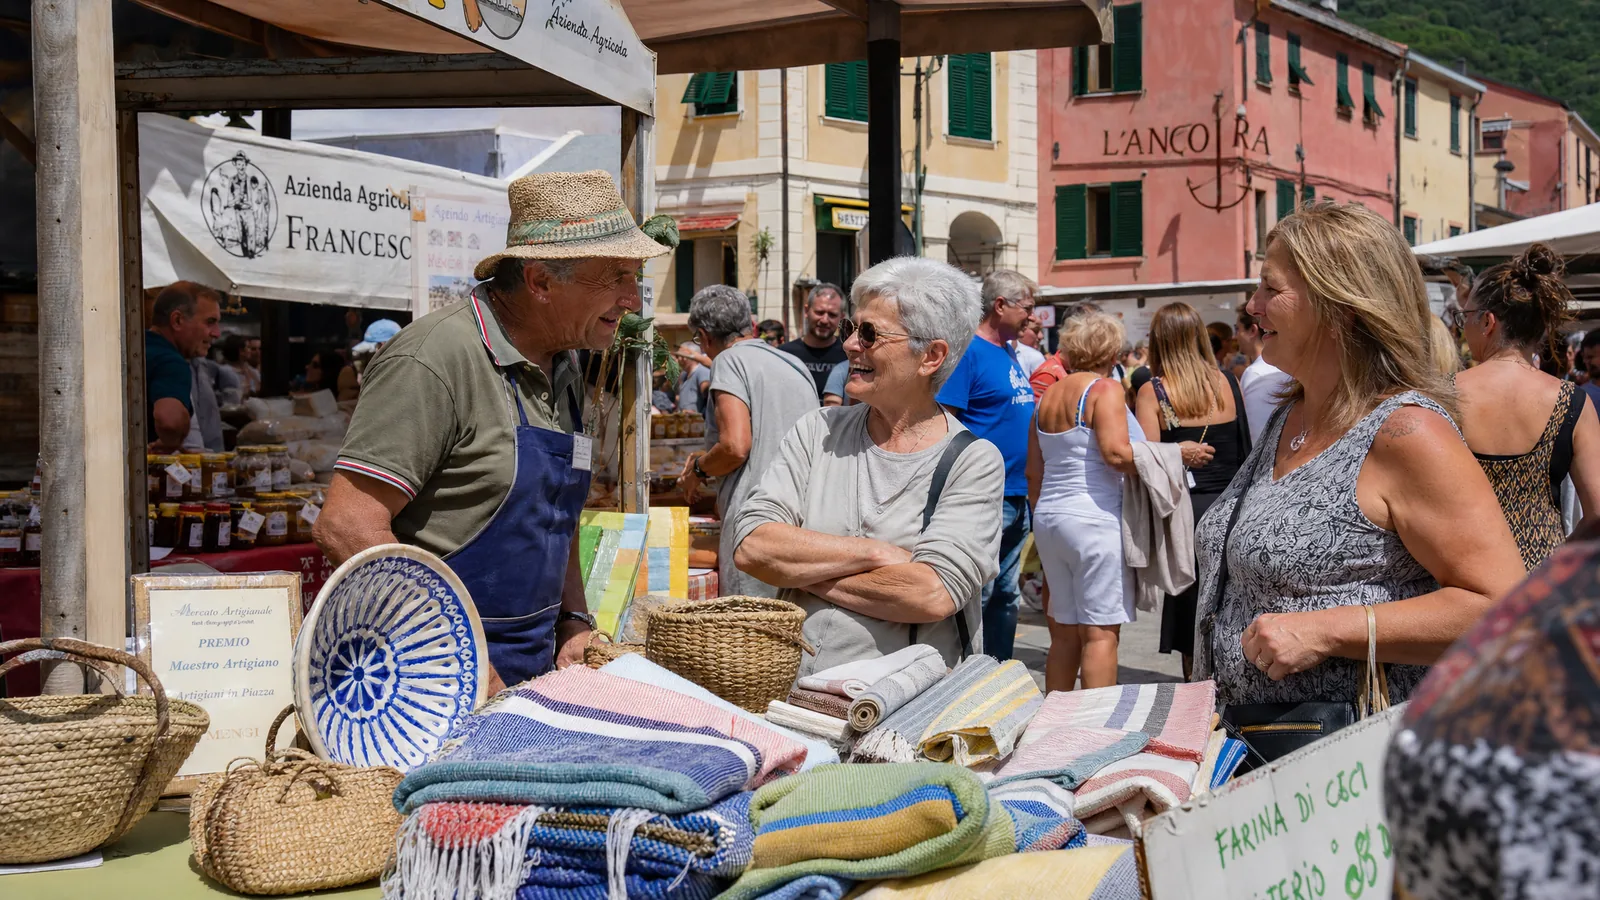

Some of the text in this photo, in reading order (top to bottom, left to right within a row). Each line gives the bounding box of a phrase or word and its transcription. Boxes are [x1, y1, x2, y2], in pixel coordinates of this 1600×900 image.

[590, 25, 628, 58] Agricola
[284, 174, 353, 203] Azienda
[170, 603, 273, 618] Mercato Artigianale
[198, 637, 250, 648] PREMIO
[169, 658, 279, 672] Maestro Artigiano
[242, 687, 275, 698] Piazza
[1215, 801, 1289, 869] FARINA
